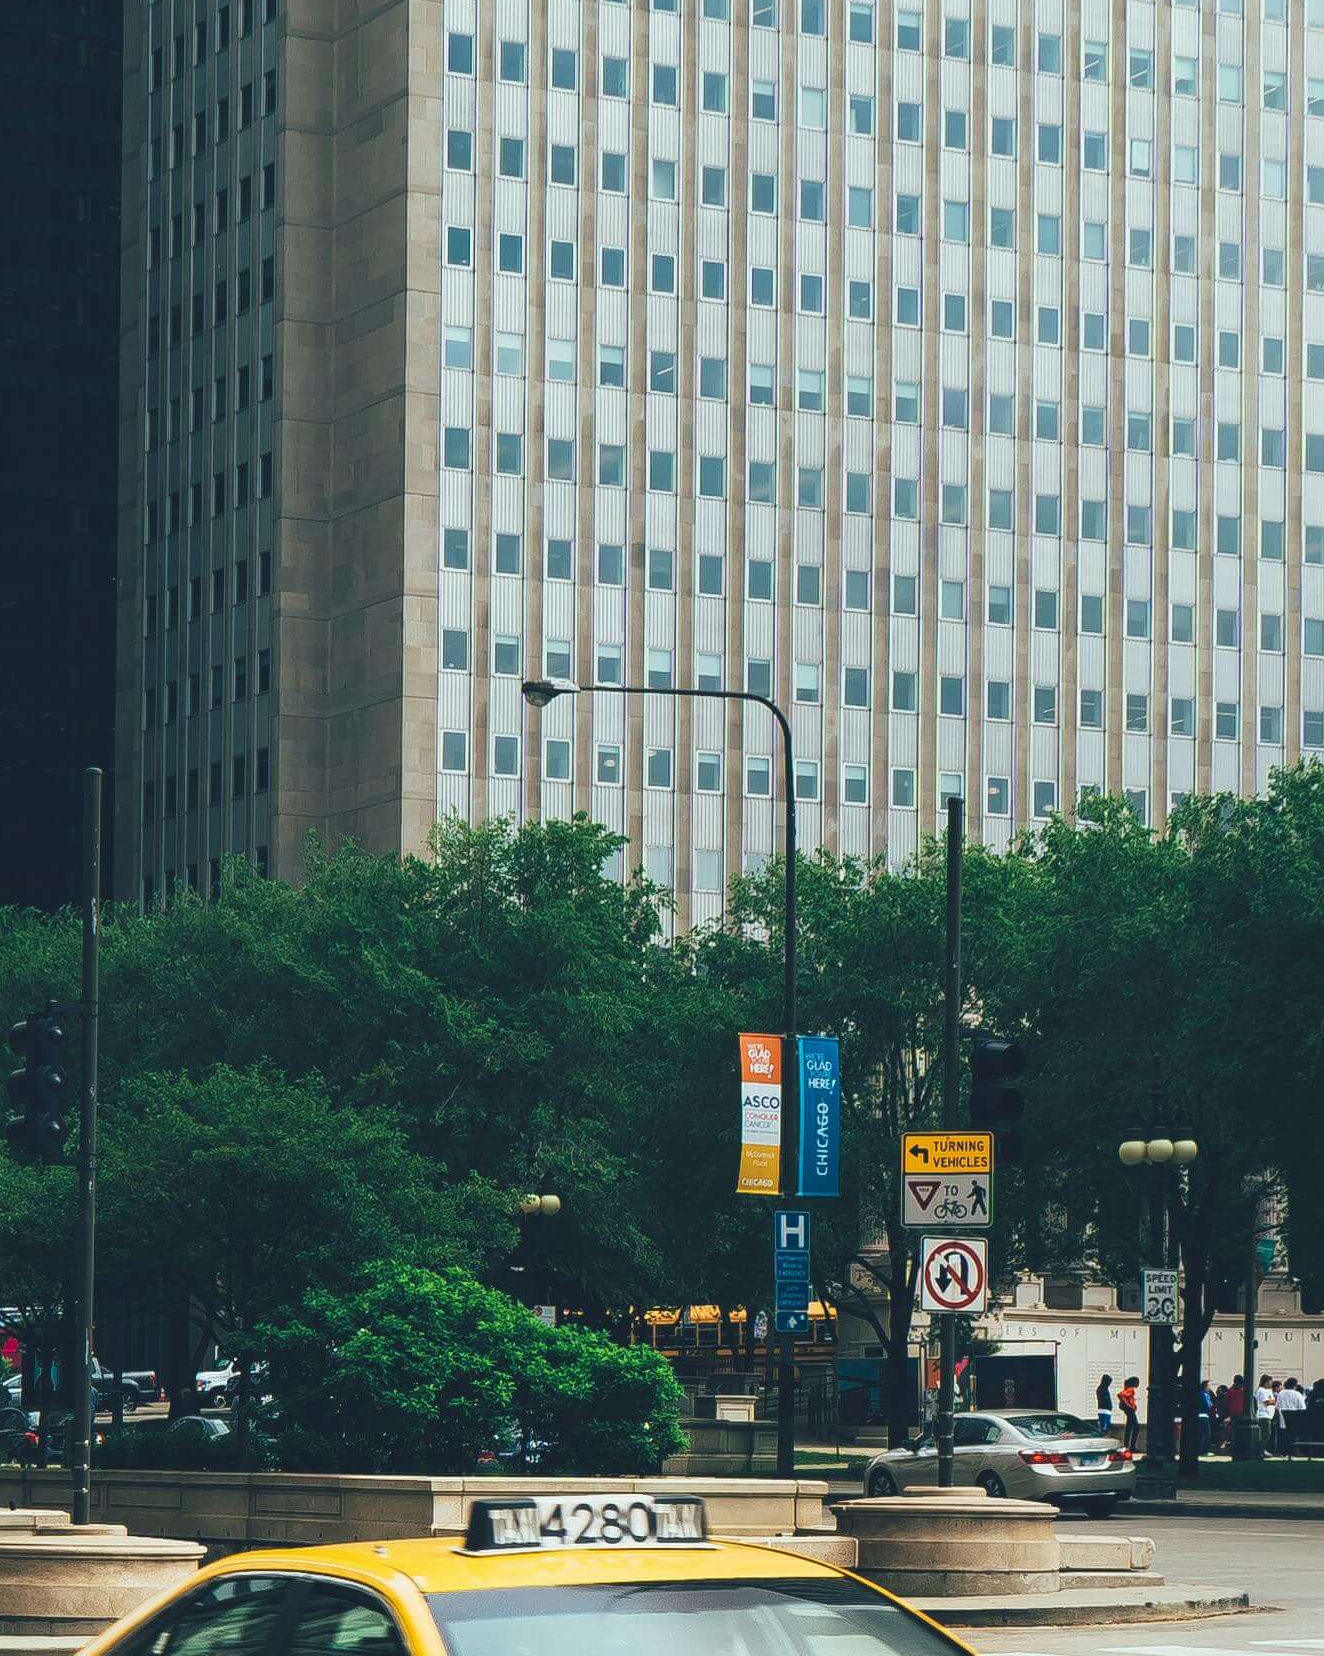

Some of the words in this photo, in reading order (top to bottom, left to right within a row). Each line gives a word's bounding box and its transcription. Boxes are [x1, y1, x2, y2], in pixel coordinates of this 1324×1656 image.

[748, 1048, 771, 1059] GLAD
[806, 1059, 832, 1071] GLAD
[808, 1078, 836, 1095] HERE!
[743, 1095, 780, 1110] ASCO
[746, 1111, 779, 1121] CONQUER
[816, 1102, 829, 1176] CHICAGO
[933, 1140, 984, 1152] TURNING
[933, 1156, 988, 1168] VEHICLES
[943, 1185, 959, 1196] TO
[780, 1214, 805, 1248] H
[1147, 1273, 1177, 1283] SPEED
[1148, 1285, 1174, 1294] LIMIT
[540, 1501, 651, 1544] 4280
